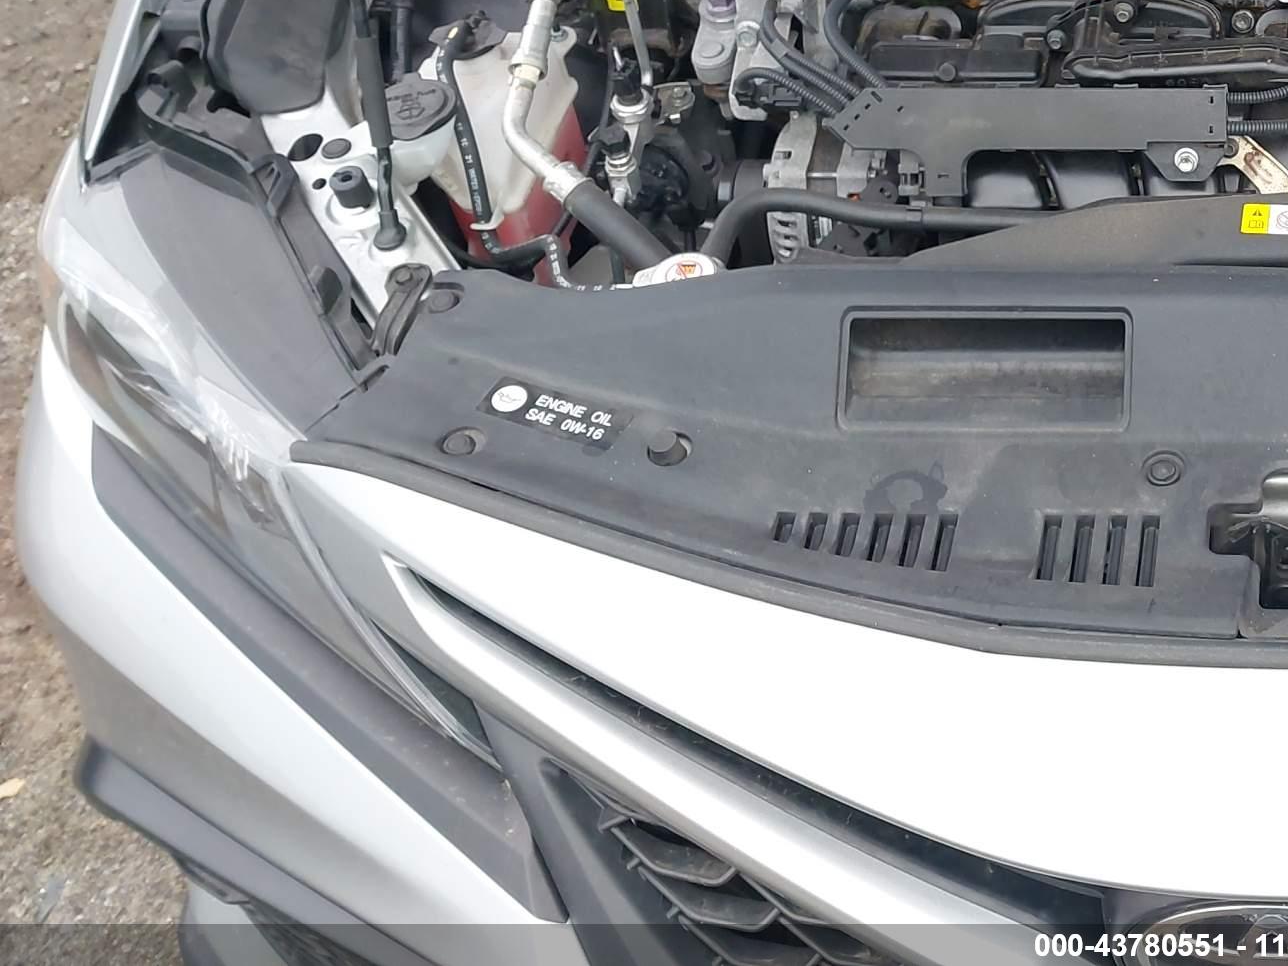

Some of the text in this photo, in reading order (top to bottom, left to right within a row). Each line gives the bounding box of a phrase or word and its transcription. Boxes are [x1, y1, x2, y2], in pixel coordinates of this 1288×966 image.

[525, 408, 605, 440] SAE 0W-16
[535, 394, 612, 427] ENGINE OIL
